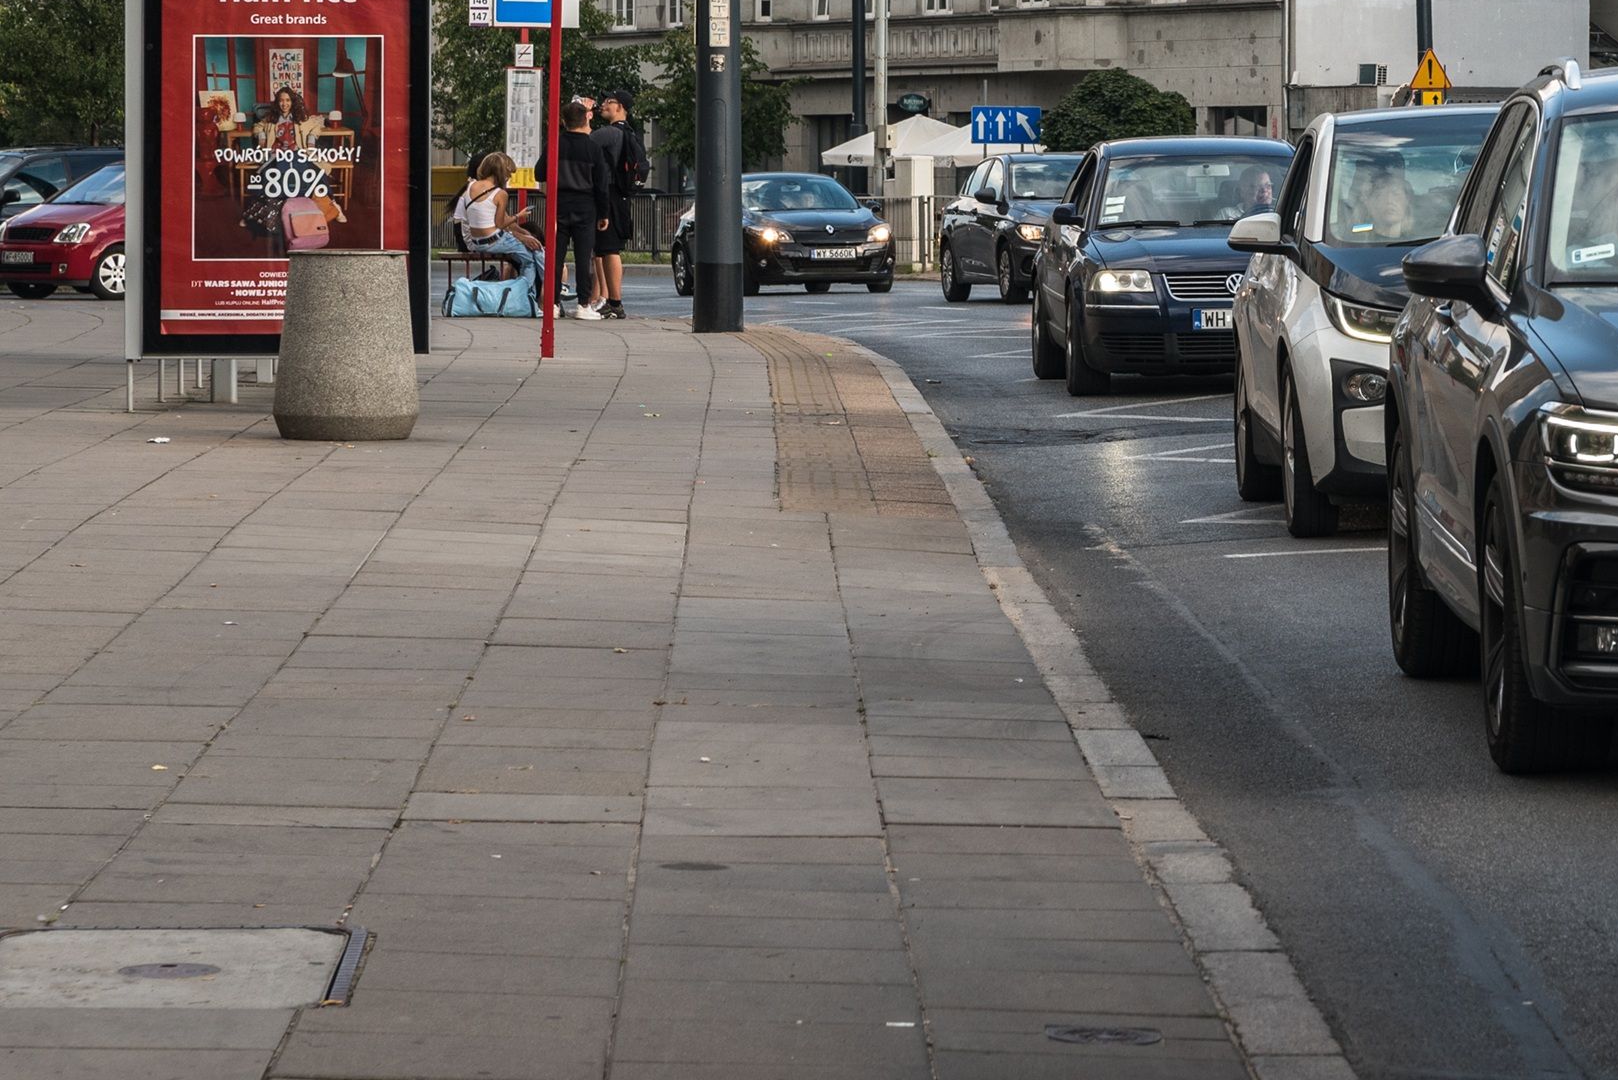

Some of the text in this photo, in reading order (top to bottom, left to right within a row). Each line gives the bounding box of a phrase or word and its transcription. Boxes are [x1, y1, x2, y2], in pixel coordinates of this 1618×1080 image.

[250, 13, 327, 26] Great brands
[472, 12, 488, 21] 147
[214, 145, 361, 164] POWRÓT DO SZKOŁY!
[250, 174, 262, 184] DO
[235, 289, 266, 297] NOWEJ
[1204, 311, 1226, 328] WH
